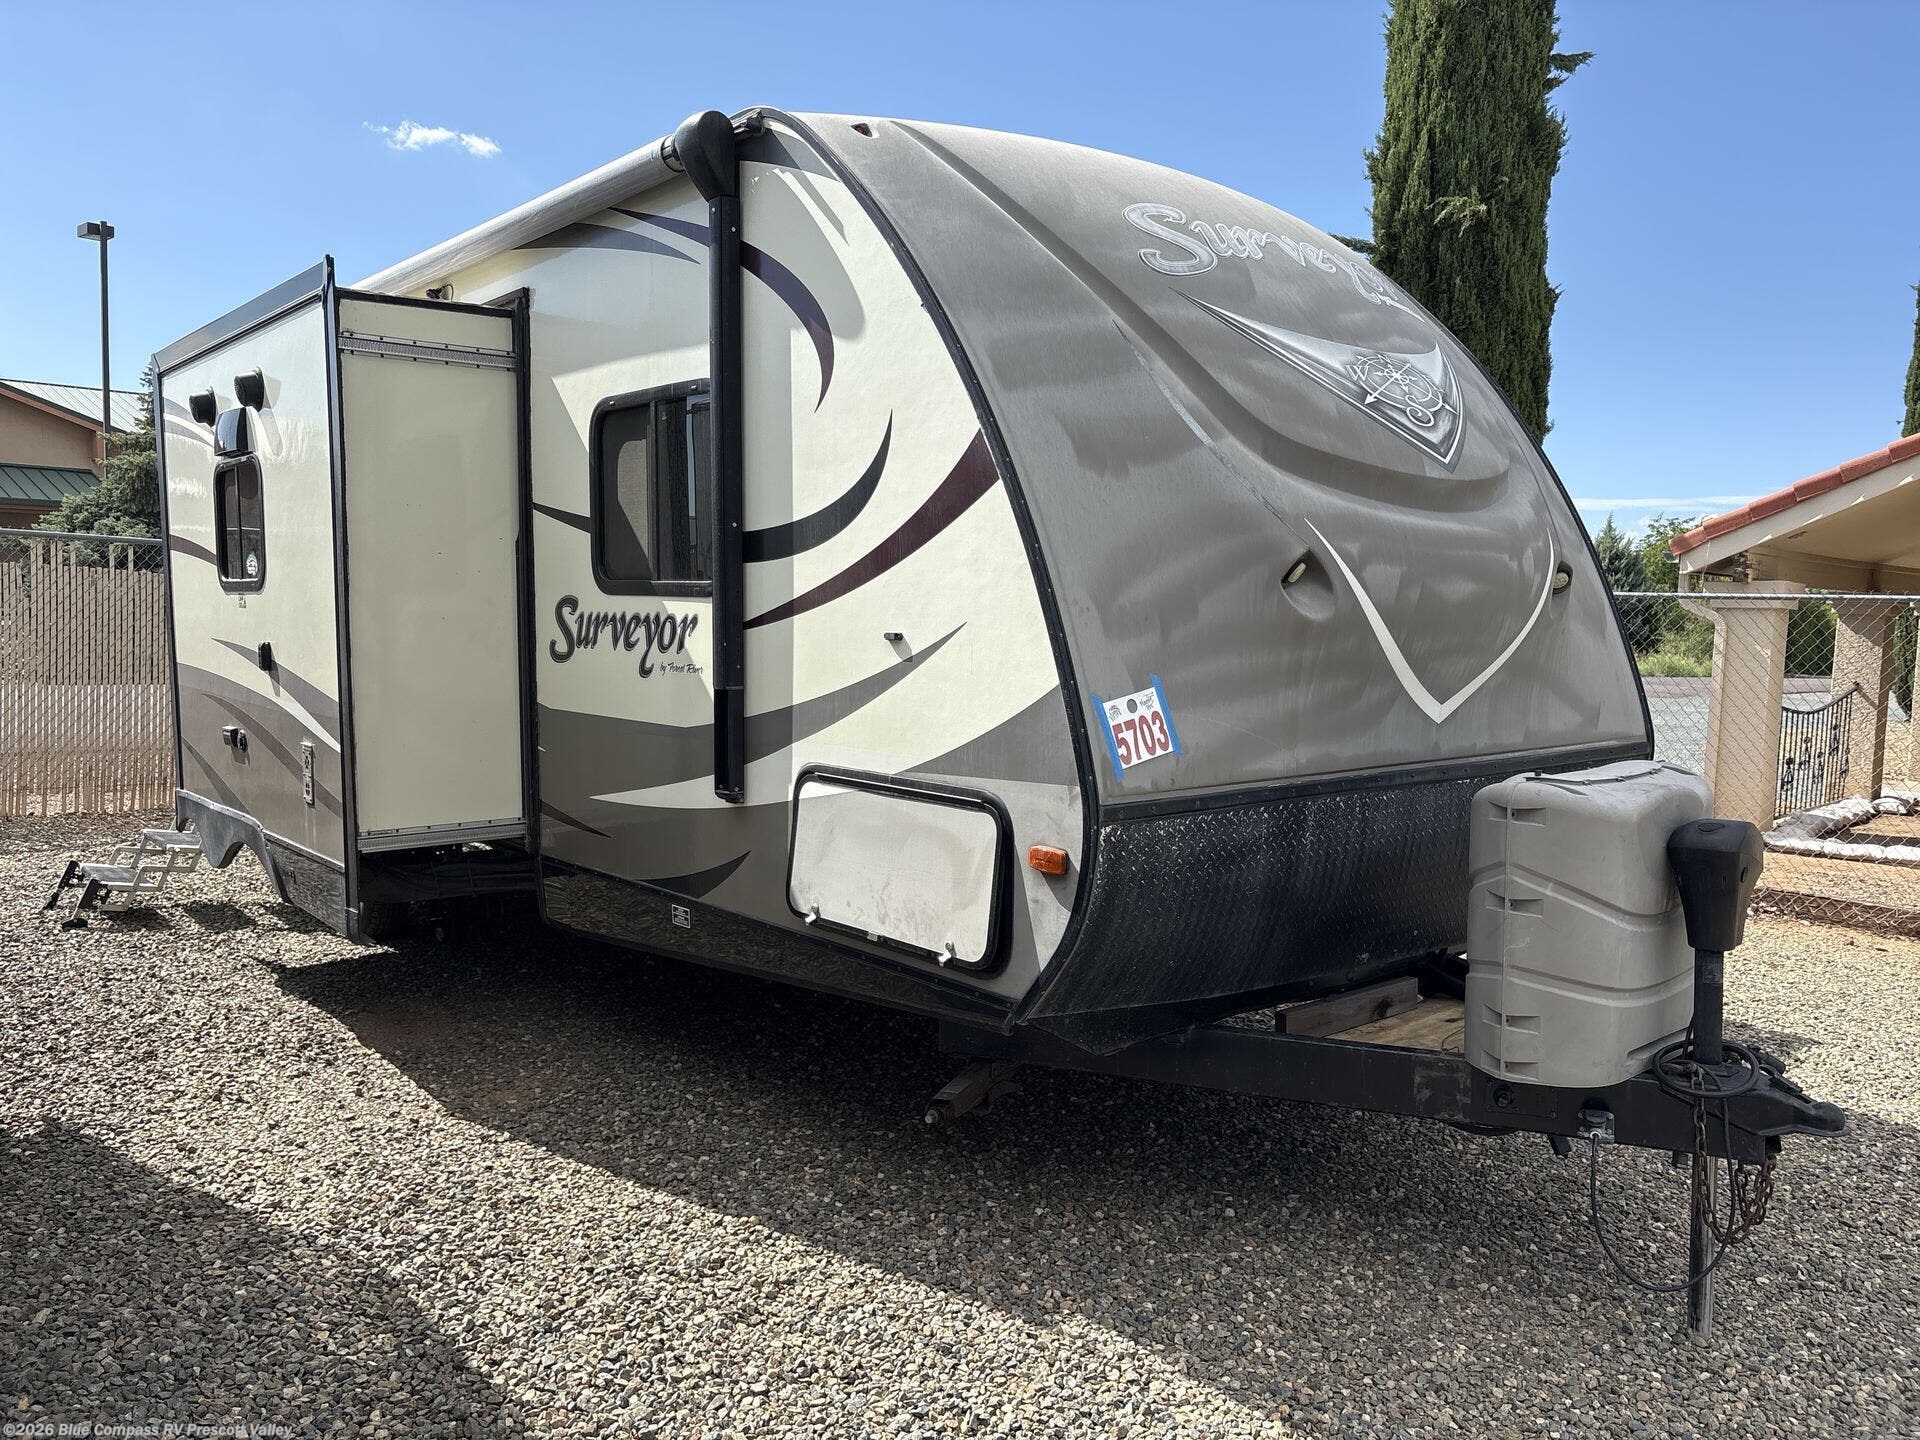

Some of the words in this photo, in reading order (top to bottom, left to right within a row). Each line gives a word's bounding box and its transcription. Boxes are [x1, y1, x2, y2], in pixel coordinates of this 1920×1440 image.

[1345, 364, 1370, 382] W
[1404, 394, 1435, 427] S
[549, 594, 699, 679] Surveyor
[1112, 710, 1170, 766] 5703
